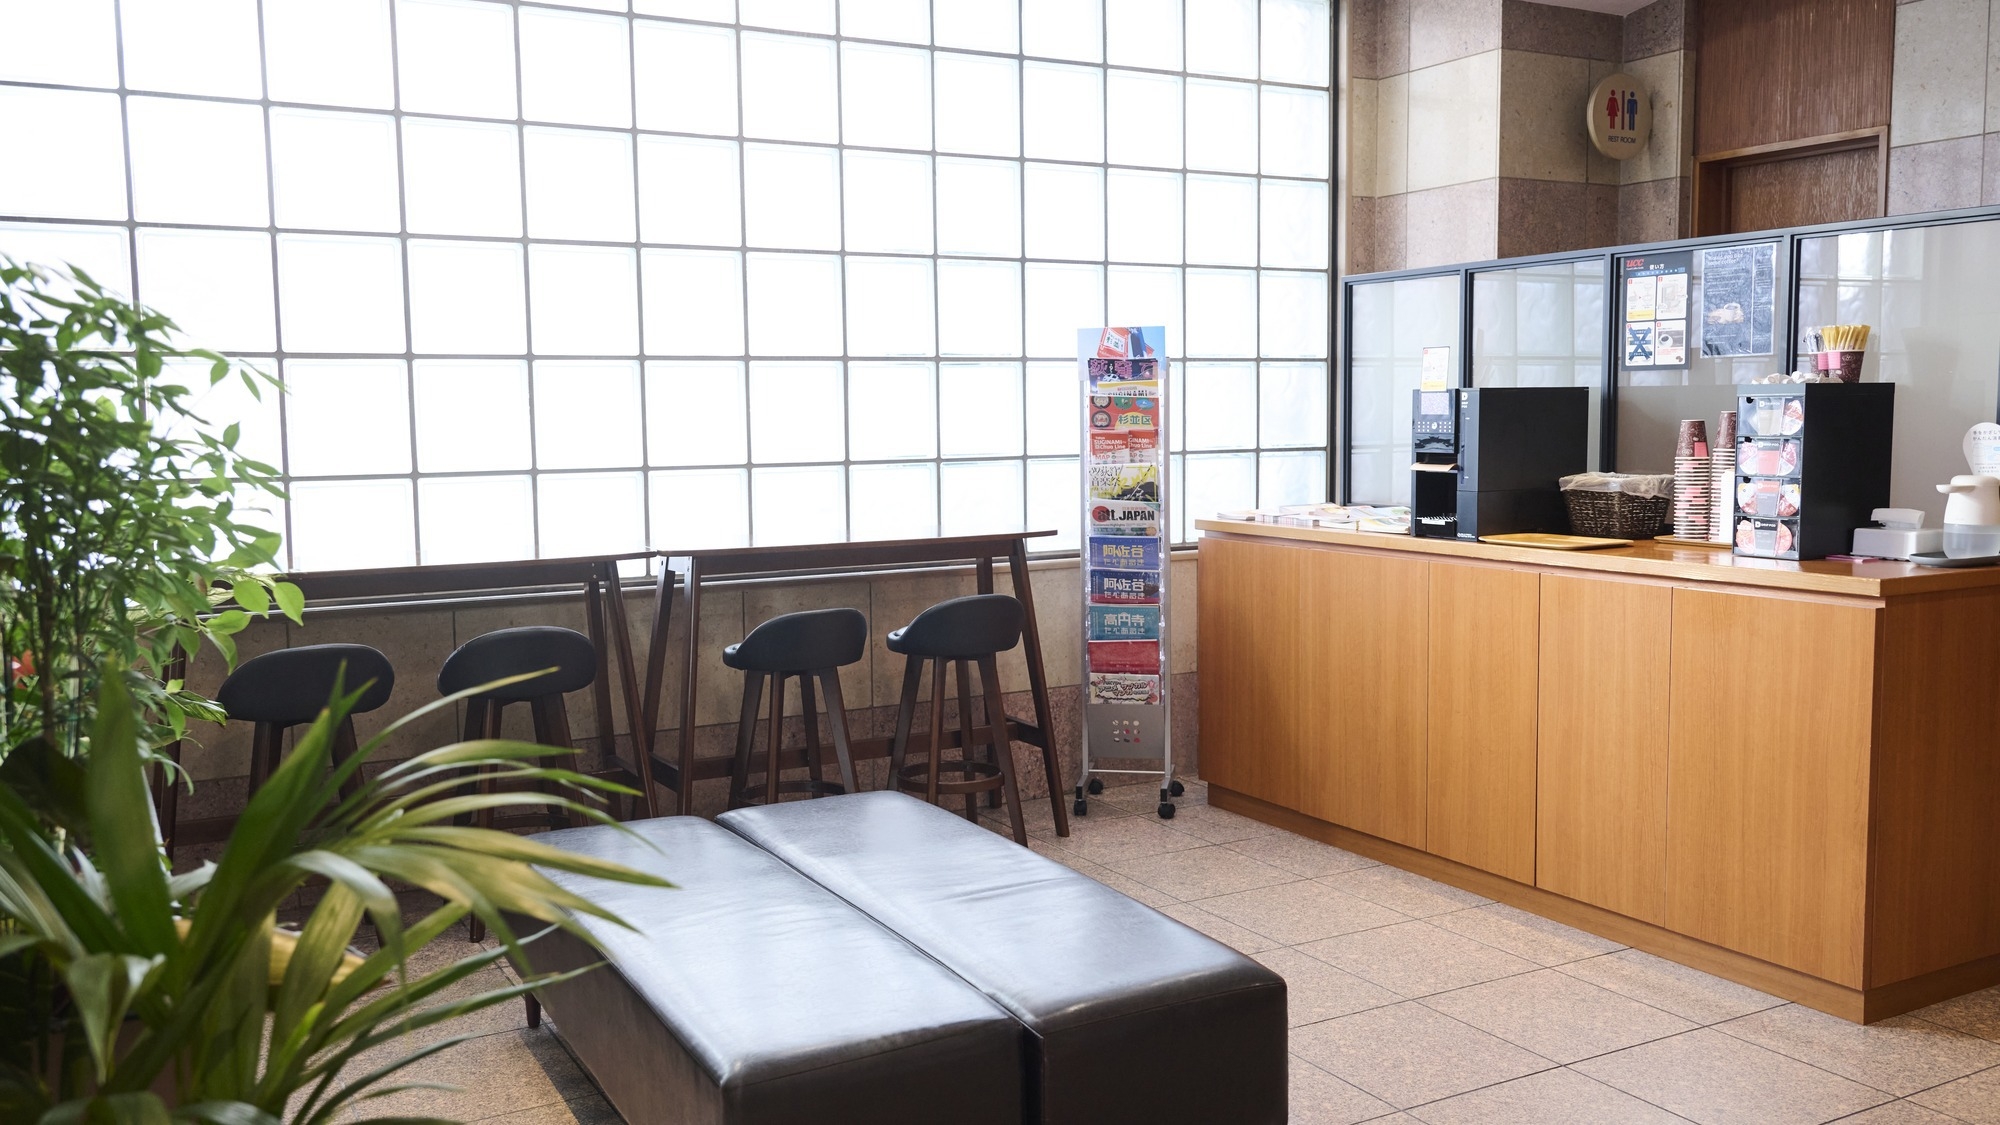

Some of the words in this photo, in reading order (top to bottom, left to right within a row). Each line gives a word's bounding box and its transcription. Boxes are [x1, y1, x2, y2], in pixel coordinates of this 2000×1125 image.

[1118, 414, 1151, 425] 杉並区
[1103, 545, 1144, 557] 阿佐谷
[1104, 578, 1145, 591] 阿佐谷
[1104, 612, 1145, 626] 高円寺
